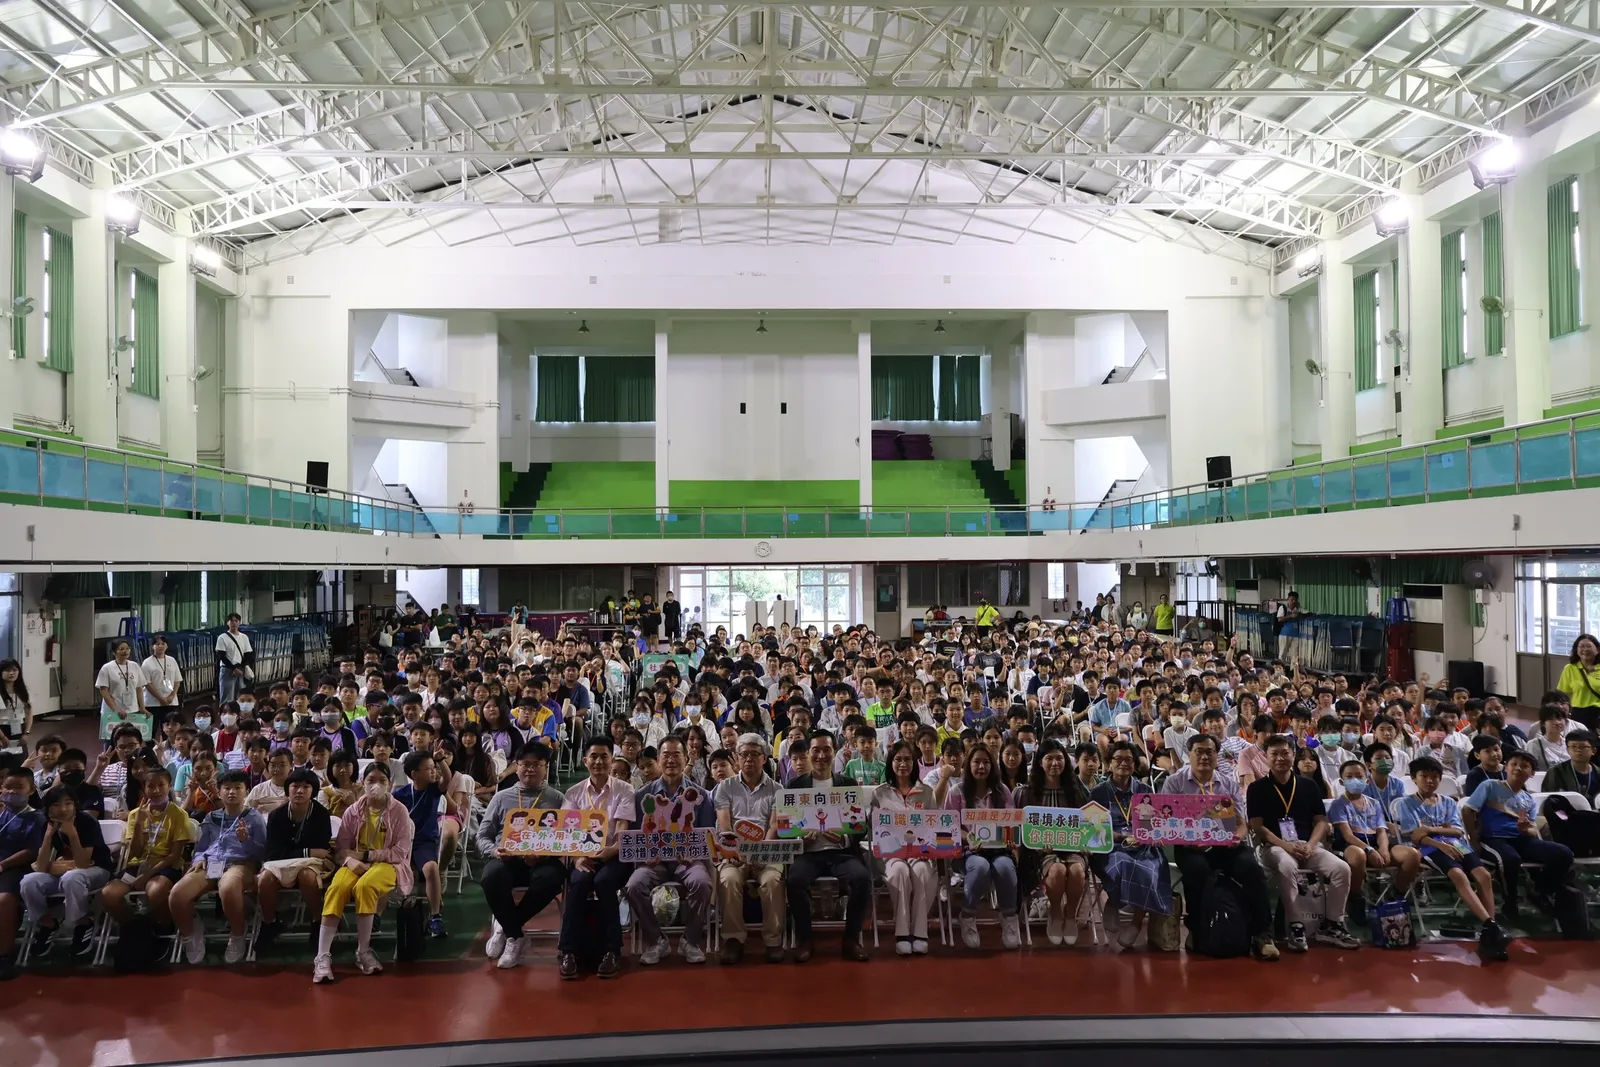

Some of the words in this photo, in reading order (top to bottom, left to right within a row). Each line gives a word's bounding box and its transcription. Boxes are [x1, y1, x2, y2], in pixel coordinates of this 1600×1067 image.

[783, 790, 857, 806] 屏東向前行
[878, 813, 953, 827] 知識學不停
[965, 810, 1023, 821] 知識是力量
[1028, 812, 1080, 829] 環境永續
[1151, 818, 1213, 829] 在家煮飯
[521, 831, 582, 841] 在外用餐
[1029, 829, 1082, 846] 你我同行
[1137, 829, 1228, 840] 吃多少煮多少
[505, 841, 596, 851] 吃多少點多少
[739, 842, 801, 853] 環境知識競賽
[749, 853, 791, 863] 屏東初賽
